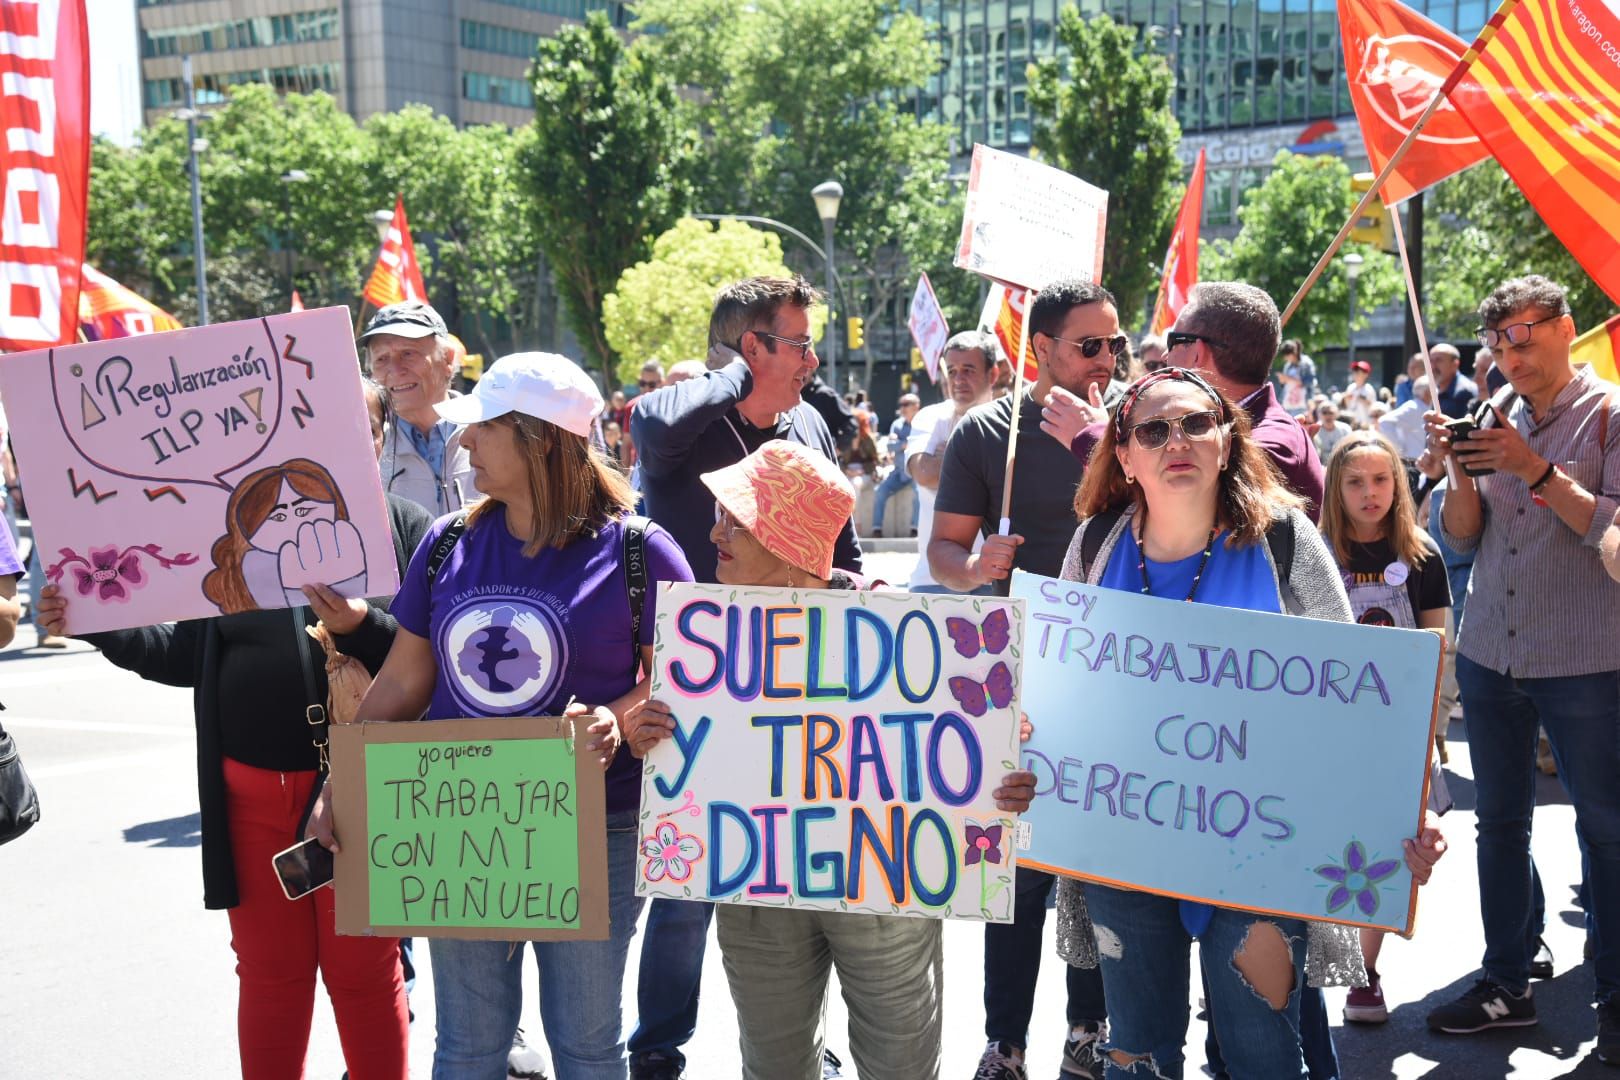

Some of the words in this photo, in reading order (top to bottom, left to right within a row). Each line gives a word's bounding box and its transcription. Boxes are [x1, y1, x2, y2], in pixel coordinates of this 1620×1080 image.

[140, 408, 203, 464] ILP
[543, 592, 569, 617] HOGAR
[666, 598, 942, 704] SUELDO
[1033, 613, 1391, 706] TRABAJADORA
[751, 711, 983, 807] TRATO
[1154, 714, 1248, 763] CON
[383, 778, 573, 825] TRABAJAR
[1022, 749, 1294, 841] DERECHOS
[370, 832, 436, 868] CON
[459, 826, 537, 870] MI
[707, 801, 959, 907] DIGNO
[400, 875, 580, 923] PAÑUELO
